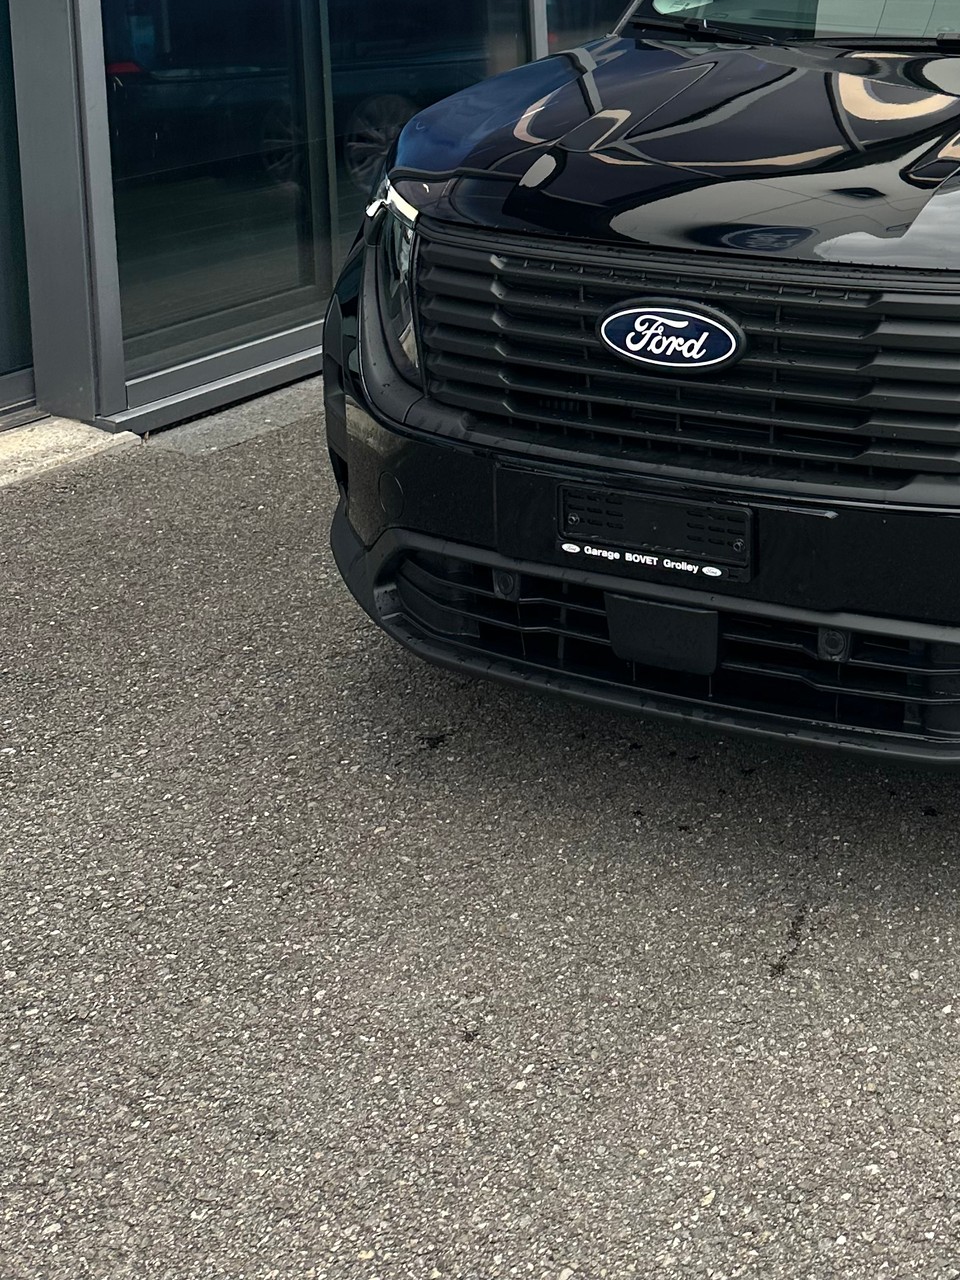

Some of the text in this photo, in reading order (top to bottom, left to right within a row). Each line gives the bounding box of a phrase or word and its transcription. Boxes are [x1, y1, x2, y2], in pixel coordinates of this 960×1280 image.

[626, 314, 710, 360] Ford
[584, 546, 620, 560] Garage
[625, 552, 659, 566] BOVET
[663, 558, 699, 574] Grolley
